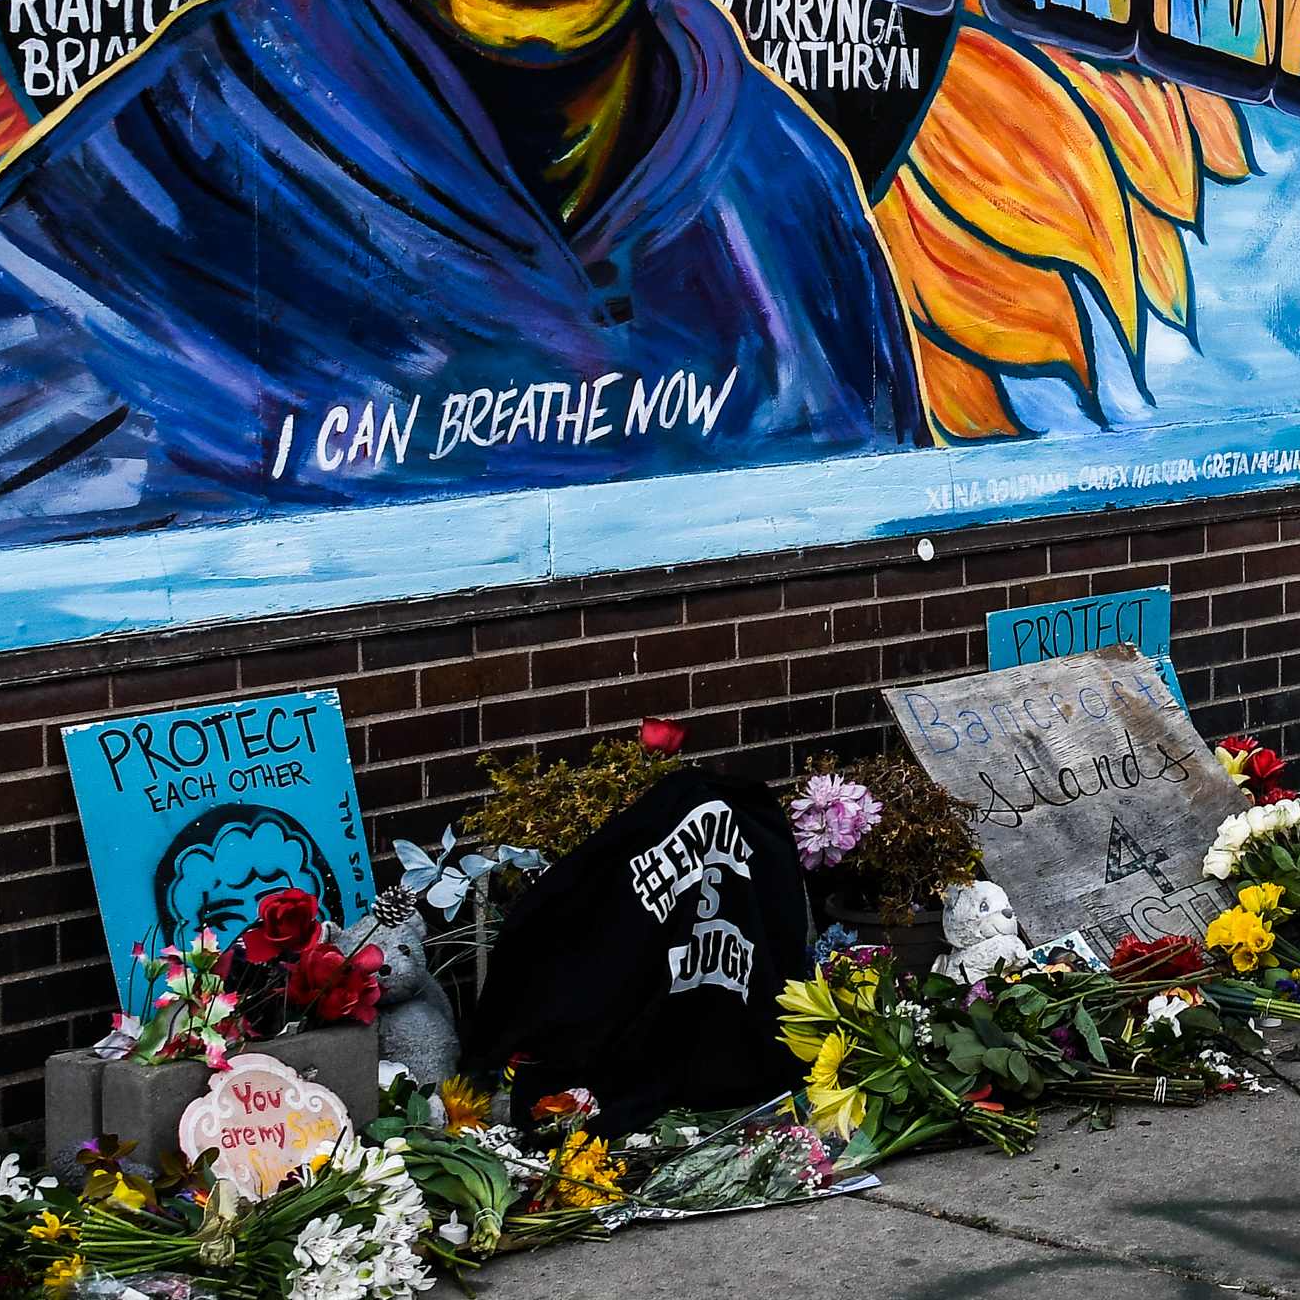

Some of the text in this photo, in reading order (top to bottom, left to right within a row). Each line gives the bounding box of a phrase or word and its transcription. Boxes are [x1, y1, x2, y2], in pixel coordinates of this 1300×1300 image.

[764, 41, 919, 92] KATHRYN
[271, 364, 740, 479] I CAN BREATHE NOW
[1201, 451, 1250, 480] GRETA
[904, 675, 1161, 755] Bancroft
[98, 707, 317, 792] PROTECT
[144, 760, 312, 813] EACH OTHER
[1105, 813, 1176, 894] 4
[233, 1082, 283, 1114] You
[221, 1126, 256, 1149] are
[260, 1121, 285, 1149] my
